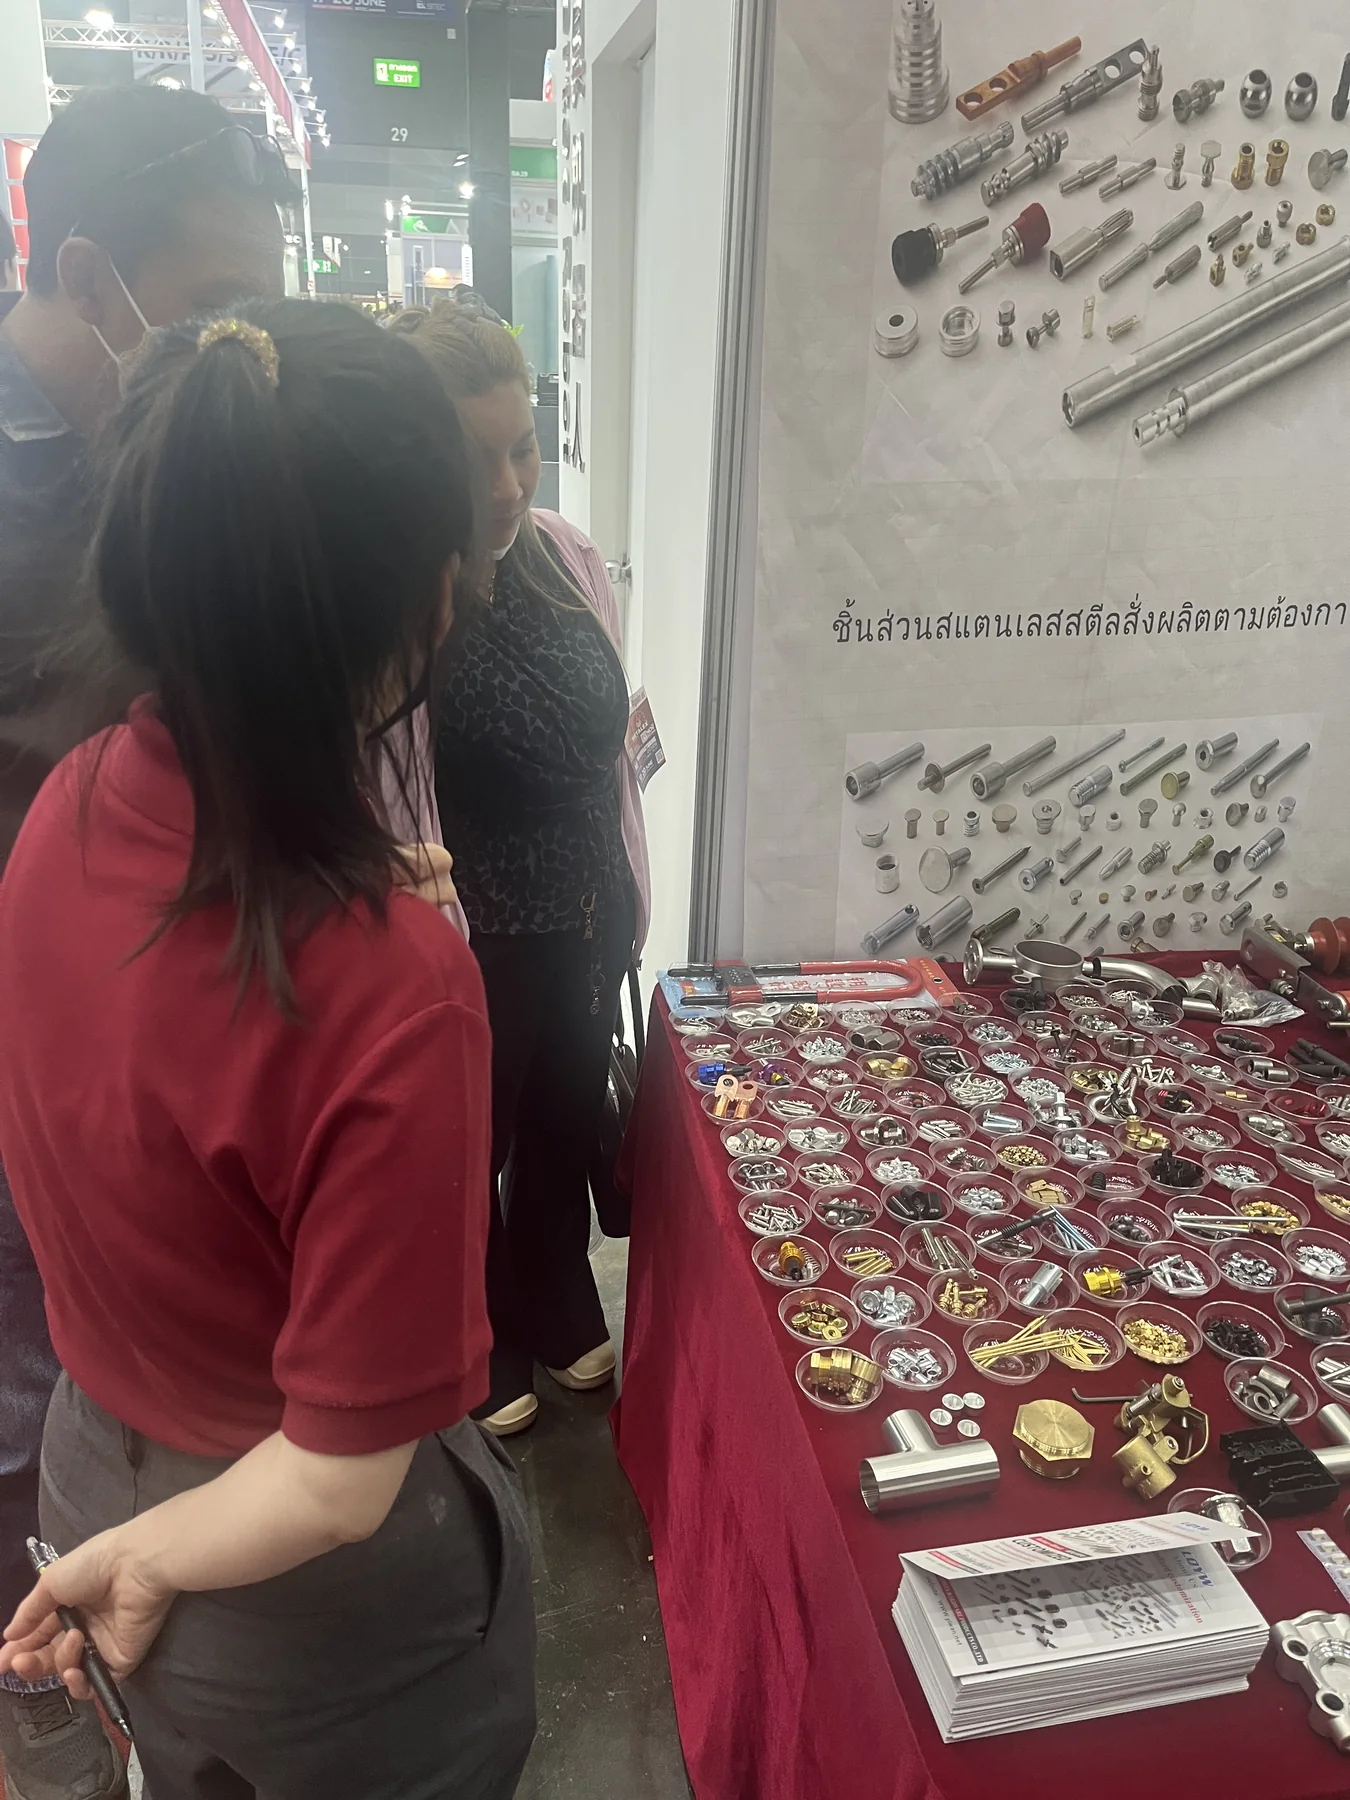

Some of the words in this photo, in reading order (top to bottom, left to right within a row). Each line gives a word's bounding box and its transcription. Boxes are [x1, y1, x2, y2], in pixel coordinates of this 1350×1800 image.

[393, 74, 413, 83] EXIT
[391, 127, 408, 142] 29
[1167, 1572, 1203, 1624] customization
